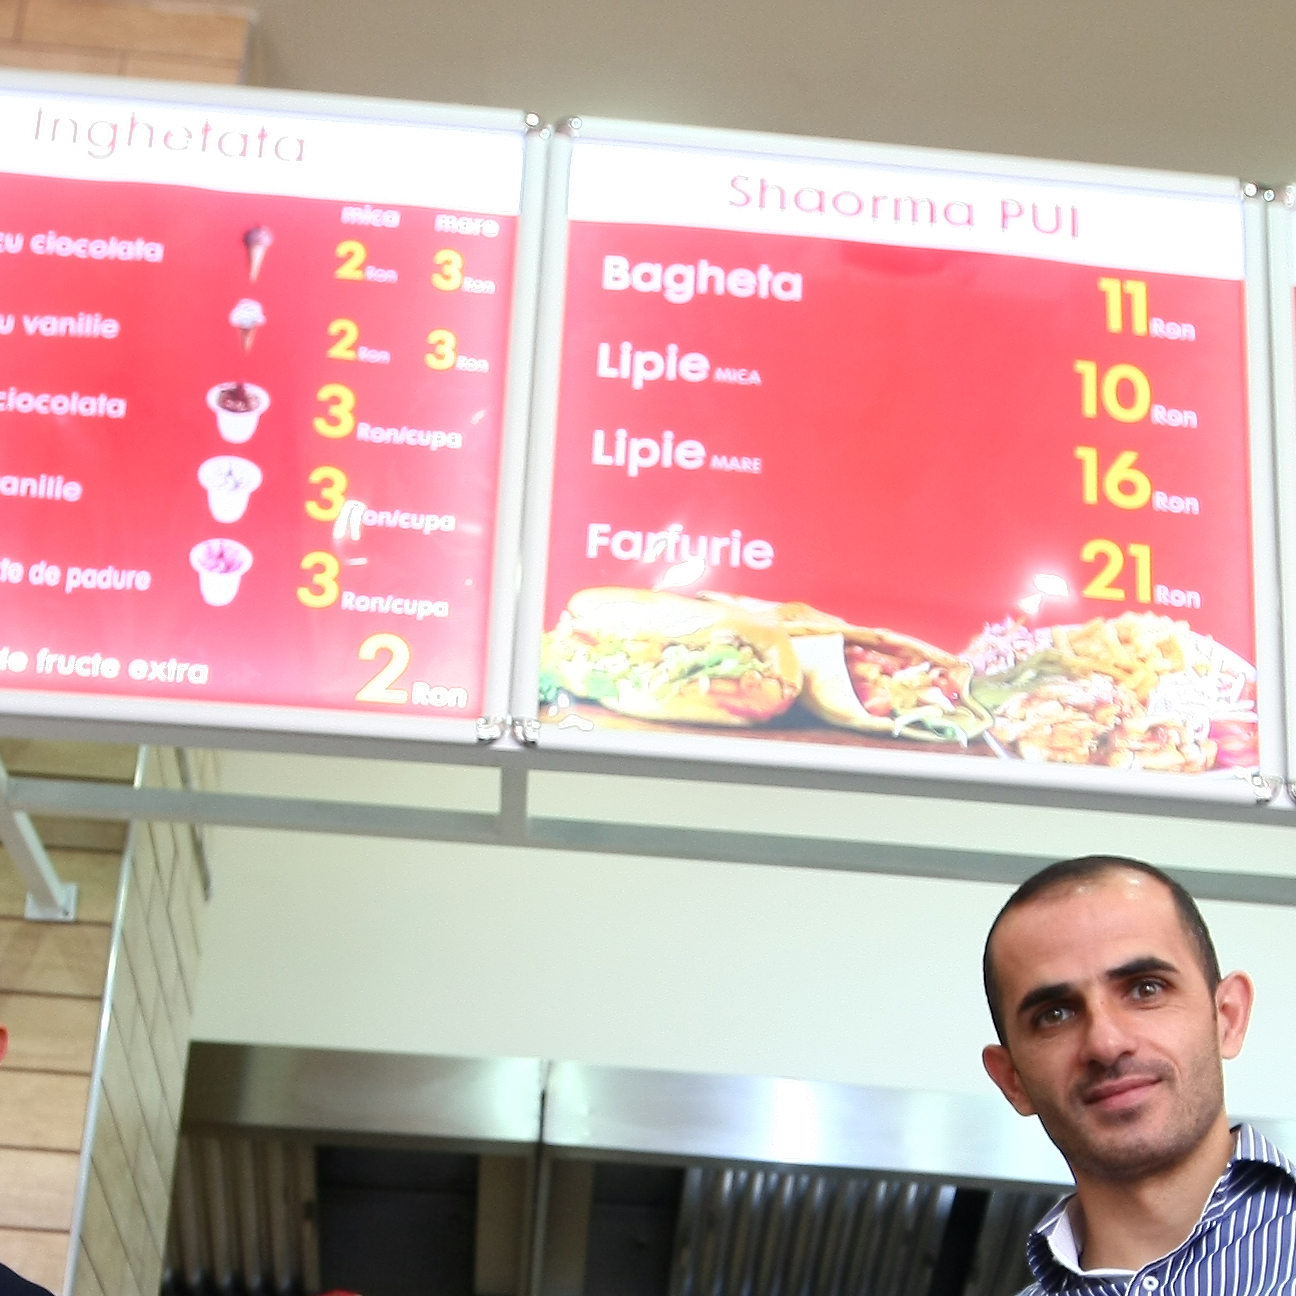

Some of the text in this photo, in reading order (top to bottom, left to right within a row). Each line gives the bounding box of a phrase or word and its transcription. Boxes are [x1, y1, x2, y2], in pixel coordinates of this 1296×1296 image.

[34, 107, 305, 162] Inghetata
[341, 205, 500, 238] mica mare
[729, 175, 1080, 240] Shaorma PUI
[30, 230, 164, 263] ciocolata
[334, 239, 397, 283] 2 Ron
[431, 249, 495, 294] 3 Ron
[602, 255, 803, 303] Bagheta
[23, 312, 119, 339] vanilie
[1097, 276, 1196, 341] 11 Ron
[327, 319, 390, 364] 2 Ron
[424, 329, 489, 373] 3 Ron
[596, 341, 762, 390] Lipie MICA
[312, 383, 462, 451] 3 Ron/cupa
[1073, 360, 1198, 428] 10 Ron
[591, 428, 762, 477] Lipie MARE
[305, 466, 349, 521] 3
[1074, 446, 1199, 515] 16 Ron
[585, 523, 775, 570] Farfurie
[29, 561, 61, 587] de
[65, 565, 151, 594] padure
[297, 551, 449, 619] 3 Ron/cupa
[1080, 539, 1201, 609] 21 Ron
[37, 647, 120, 679] fructe
[129, 657, 209, 685] extra
[354, 633, 467, 709] 2 Ron
